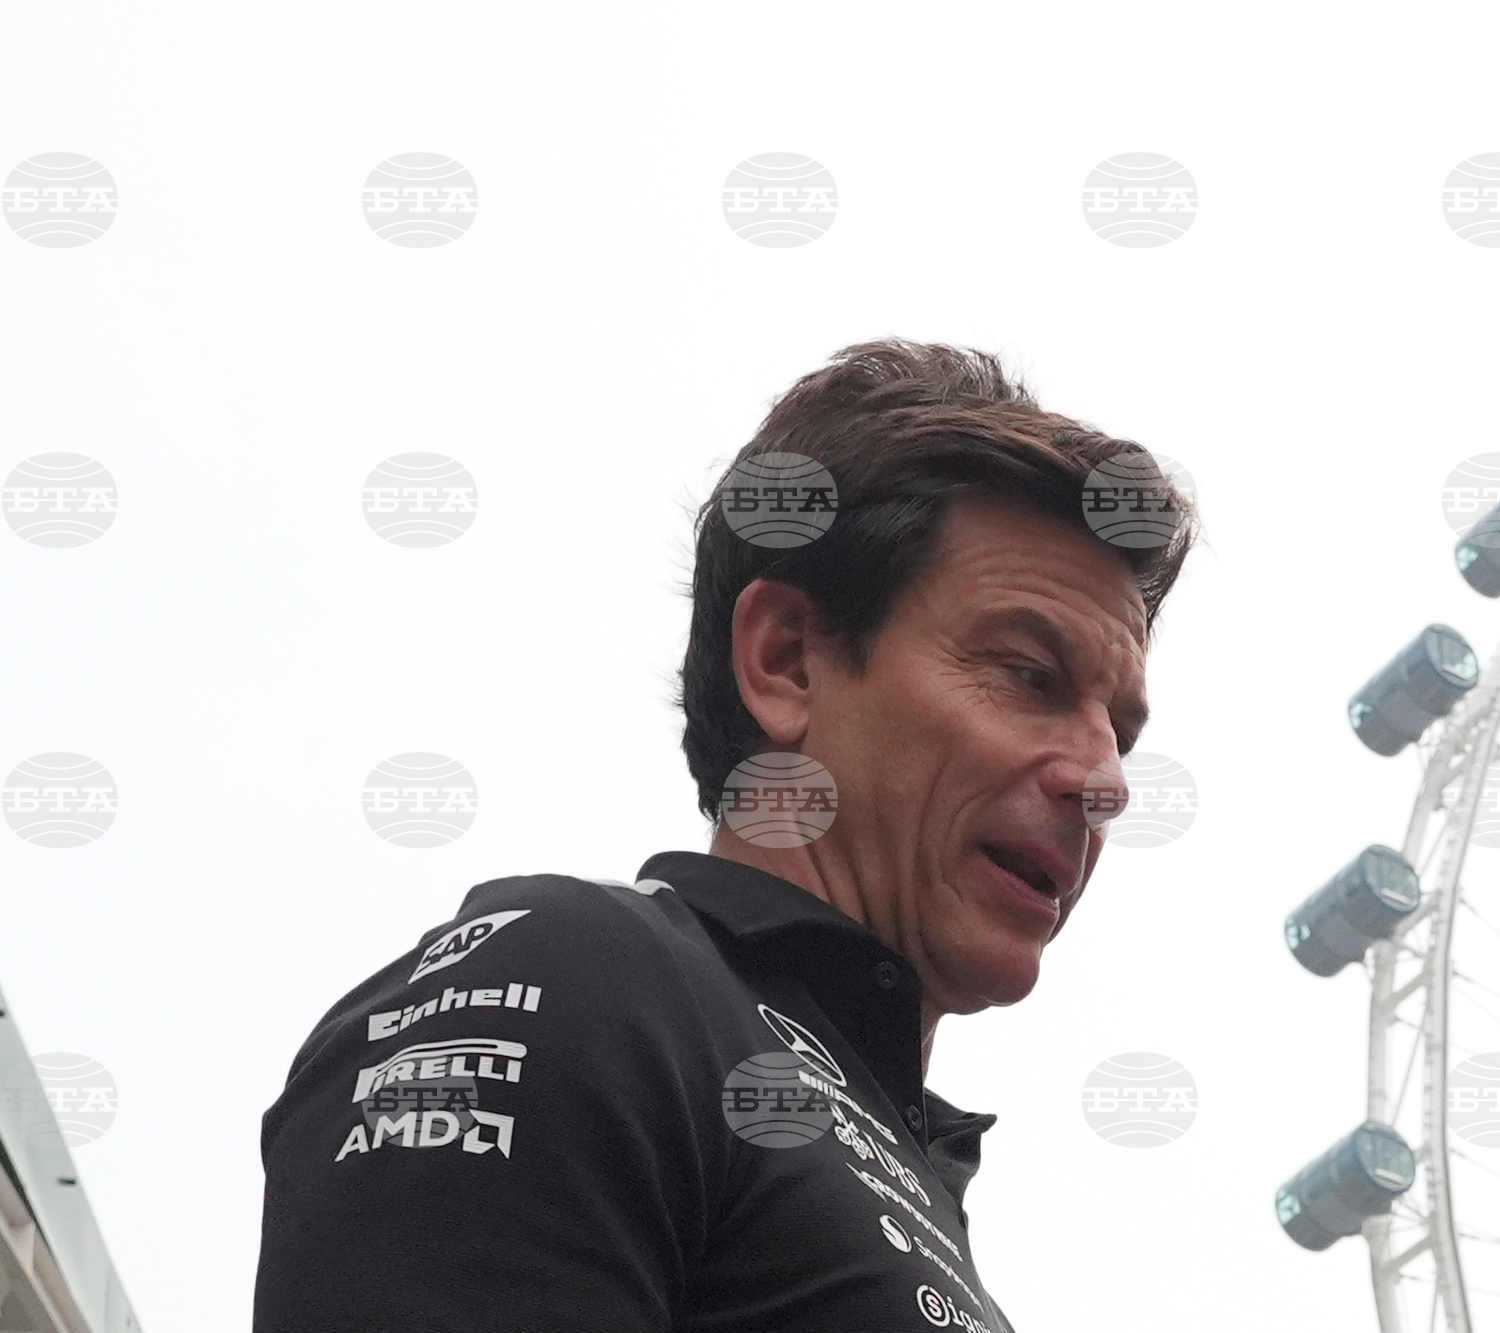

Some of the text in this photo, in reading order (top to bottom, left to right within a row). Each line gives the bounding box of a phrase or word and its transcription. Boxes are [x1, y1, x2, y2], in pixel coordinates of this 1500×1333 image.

[368, 983, 542, 1042] Einhell
[352, 1038, 527, 1103] PIRELLI
[334, 1110, 460, 1163] AMD
